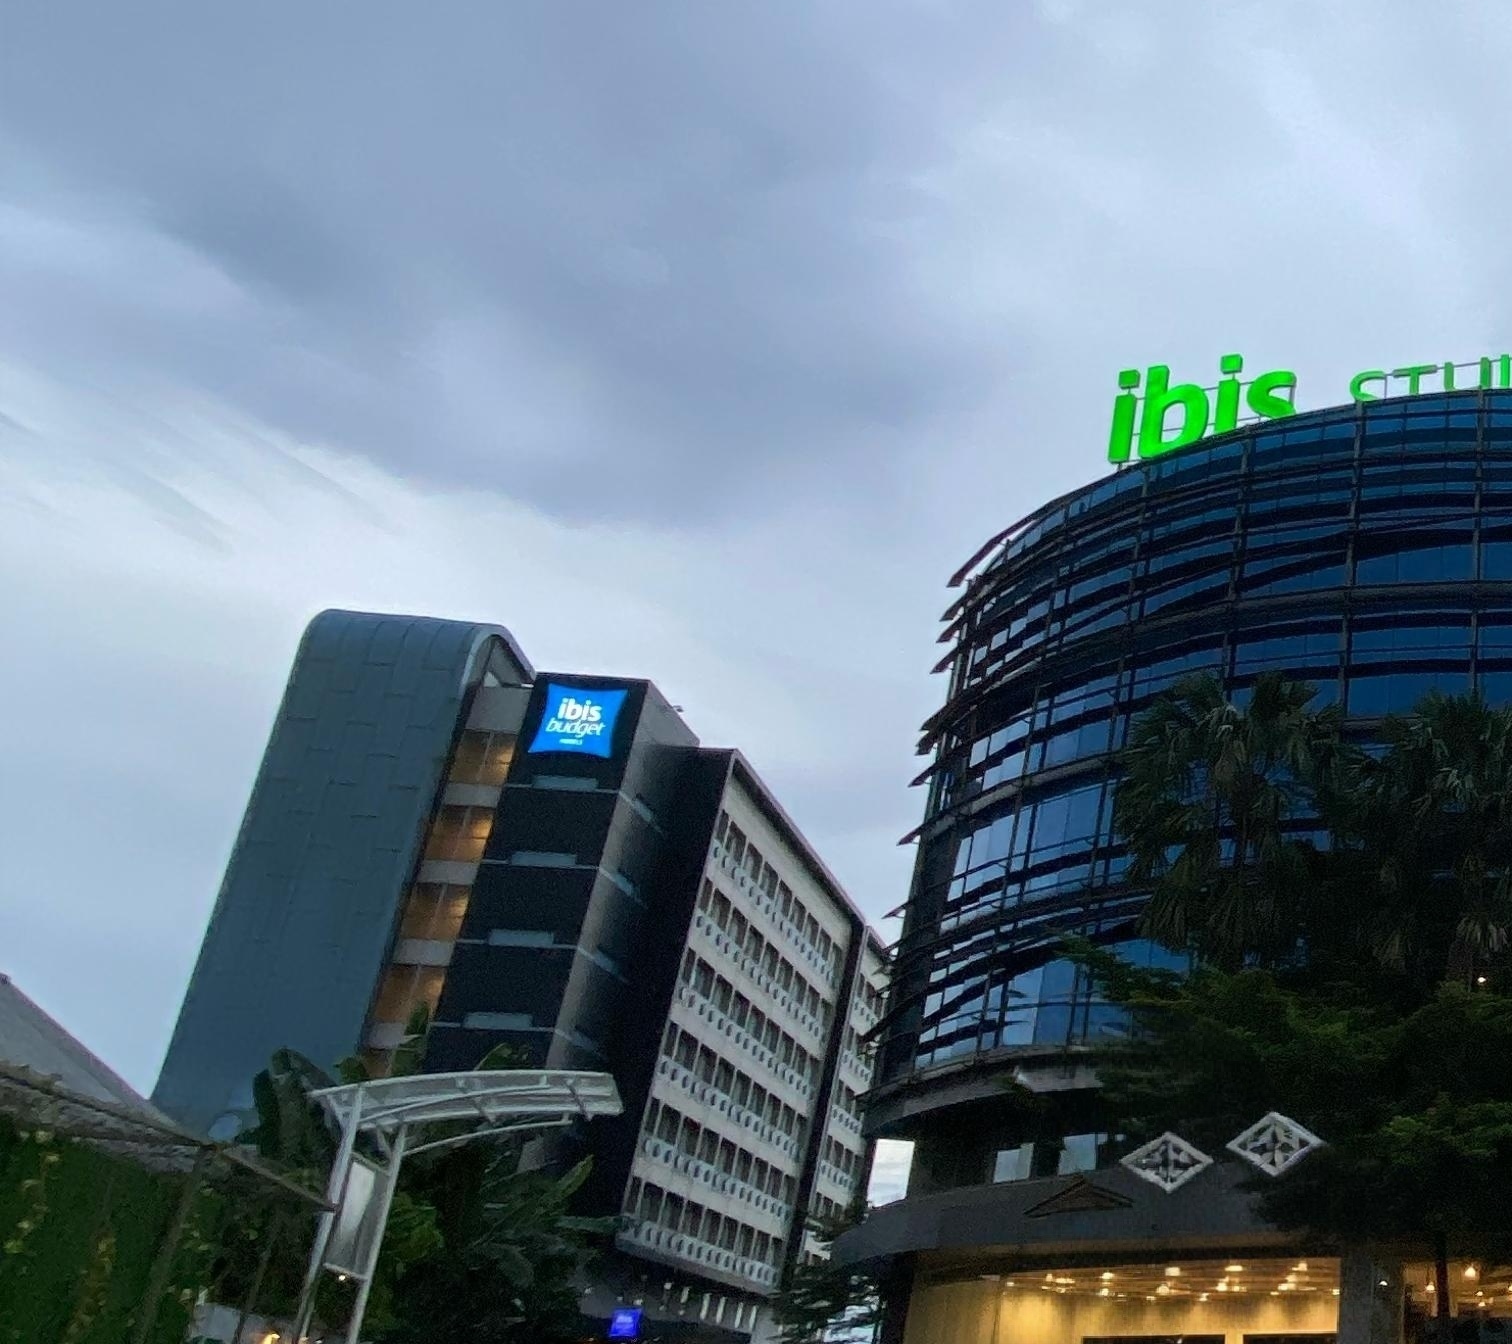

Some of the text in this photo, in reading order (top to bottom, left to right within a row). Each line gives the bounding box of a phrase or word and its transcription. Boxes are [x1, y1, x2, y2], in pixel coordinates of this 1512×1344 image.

[1107, 354, 1296, 463] ibis
[557, 697, 602, 722] ibis
[545, 717, 606, 738] budget
